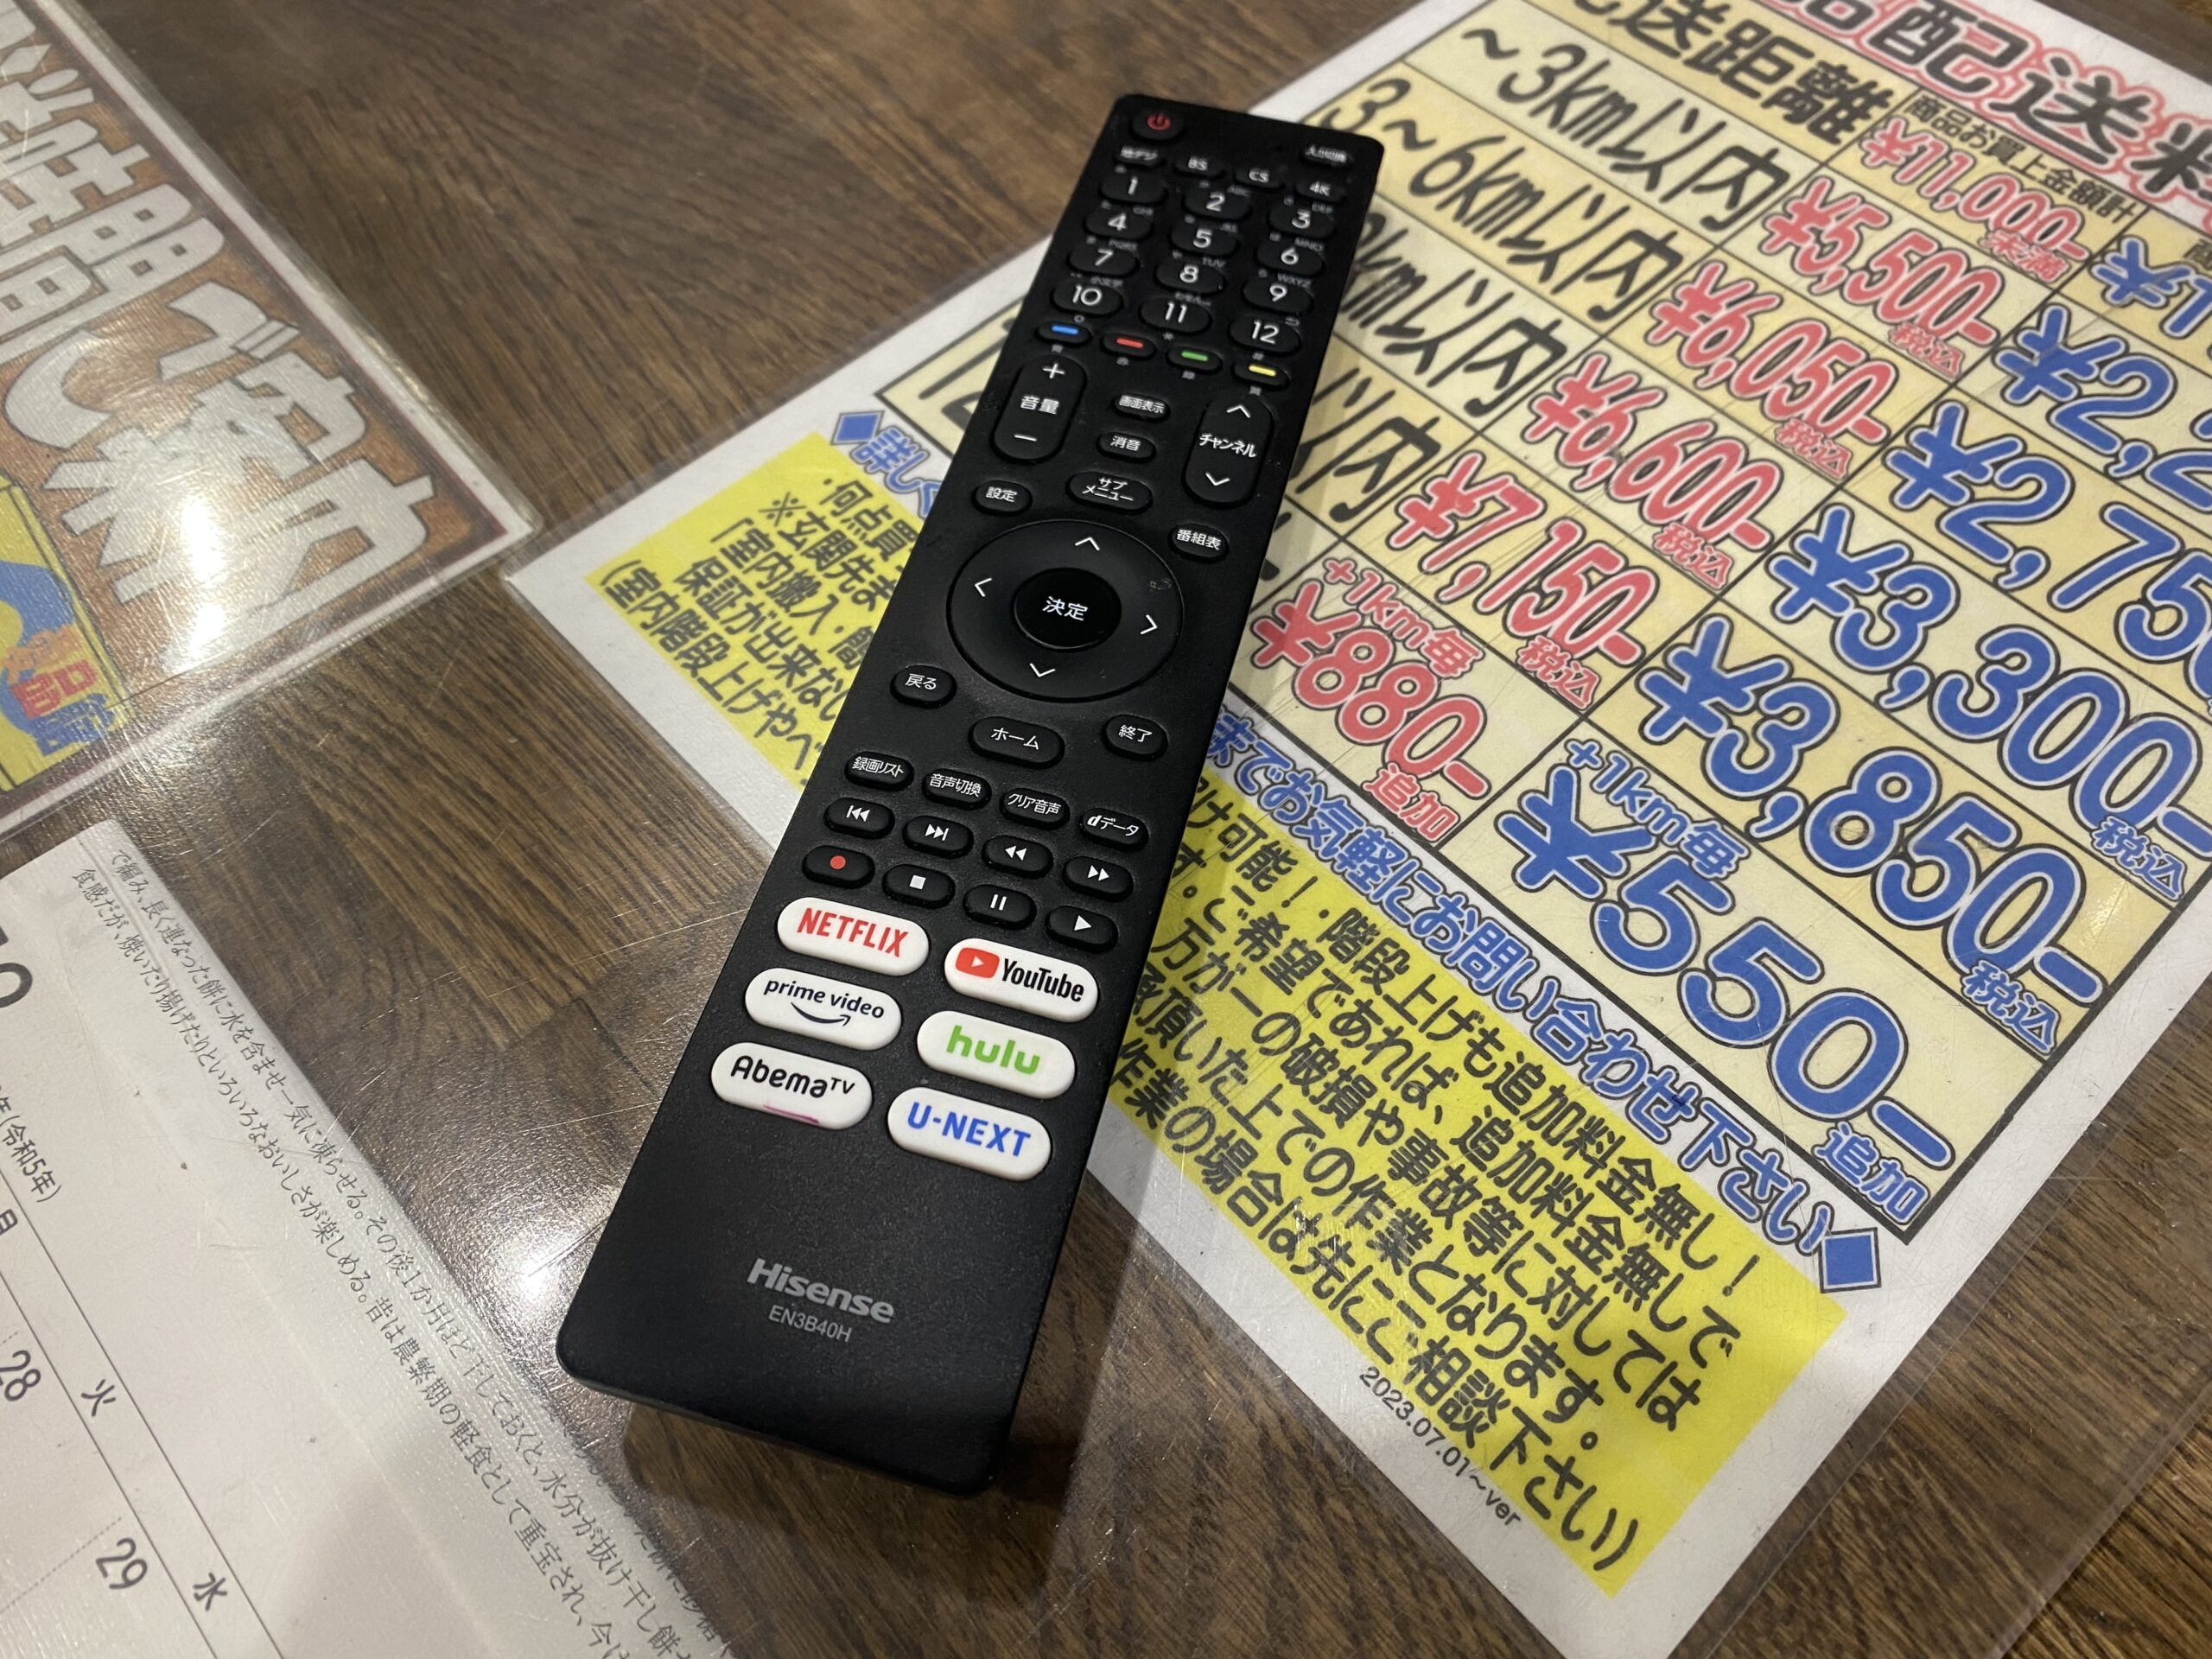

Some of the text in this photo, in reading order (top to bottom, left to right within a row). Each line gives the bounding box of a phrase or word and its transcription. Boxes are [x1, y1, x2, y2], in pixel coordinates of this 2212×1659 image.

[1187, 156, 1208, 172] BS
[1904, 92, 2136, 224] 商品お買上金額計
[1128, 175, 1139, 195] 1
[1249, 168, 1270, 184] CS
[1309, 181, 1332, 197] 4K
[1205, 192, 1226, 213] 2
[1107, 213, 1127, 232] 4
[1291, 208, 1312, 230] 3
[1192, 227, 1212, 248] 5
[1095, 247, 1114, 266] 7
[1281, 247, 1300, 265] 6
[1179, 264, 1199, 283] 8
[1072, 285, 1103, 305] 10
[1268, 283, 1288, 302] 9
[1165, 302, 1187, 324] 11
[0, 0, 434, 676] 時間ご案内
[1251, 320, 1281, 345] 12
[1020, 395, 1060, 416] 音量
[1119, 395, 1165, 415] 画面表示
[1110, 435, 1141, 451] 消音
[1198, 433, 1257, 459] チャンネル
[1776, 417, 1853, 480] 税込
[985, 486, 1018, 503] 設定
[1081, 485, 1135, 502] メニュー
[1098, 476, 1128, 490] サブ
[1176, 528, 1222, 550] 番組表
[1651, 524, 1734, 590] 税込
[1042, 594, 1089, 621] 決定
[905, 672, 938, 691] 戻る
[1516, 636, 1600, 709] 税込
[990, 727, 1039, 750] ホーム
[1118, 724, 1153, 744] 終了
[852, 755, 905, 778] 録画リスト
[929, 772, 982, 798] 音声切換
[1007, 792, 1062, 816] クリア音声
[1363, 762, 1460, 843] 追加
[2089, 814, 2188, 901] 税込
[797, 908, 908, 958] NETFLIX
[1001, 957, 1085, 1003] YouTube
[764, 979, 885, 1020] prime video
[1961, 958, 2062, 1055] 税込
[946, 1025, 1040, 1075] hulu
[731, 1055, 855, 1098] AbemaTV
[907, 1102, 1031, 1156] U-NEXT
[1814, 1121, 1930, 1226] 追加
[747, 1257, 894, 1324] Hisense
[768, 1305, 853, 1342] EN3B40H
[0, 1350, 41, 1402] 28
[81, 1379, 116, 1416] 火
[95, 1537, 148, 1591] 29
[193, 1572, 227, 1611] 水
